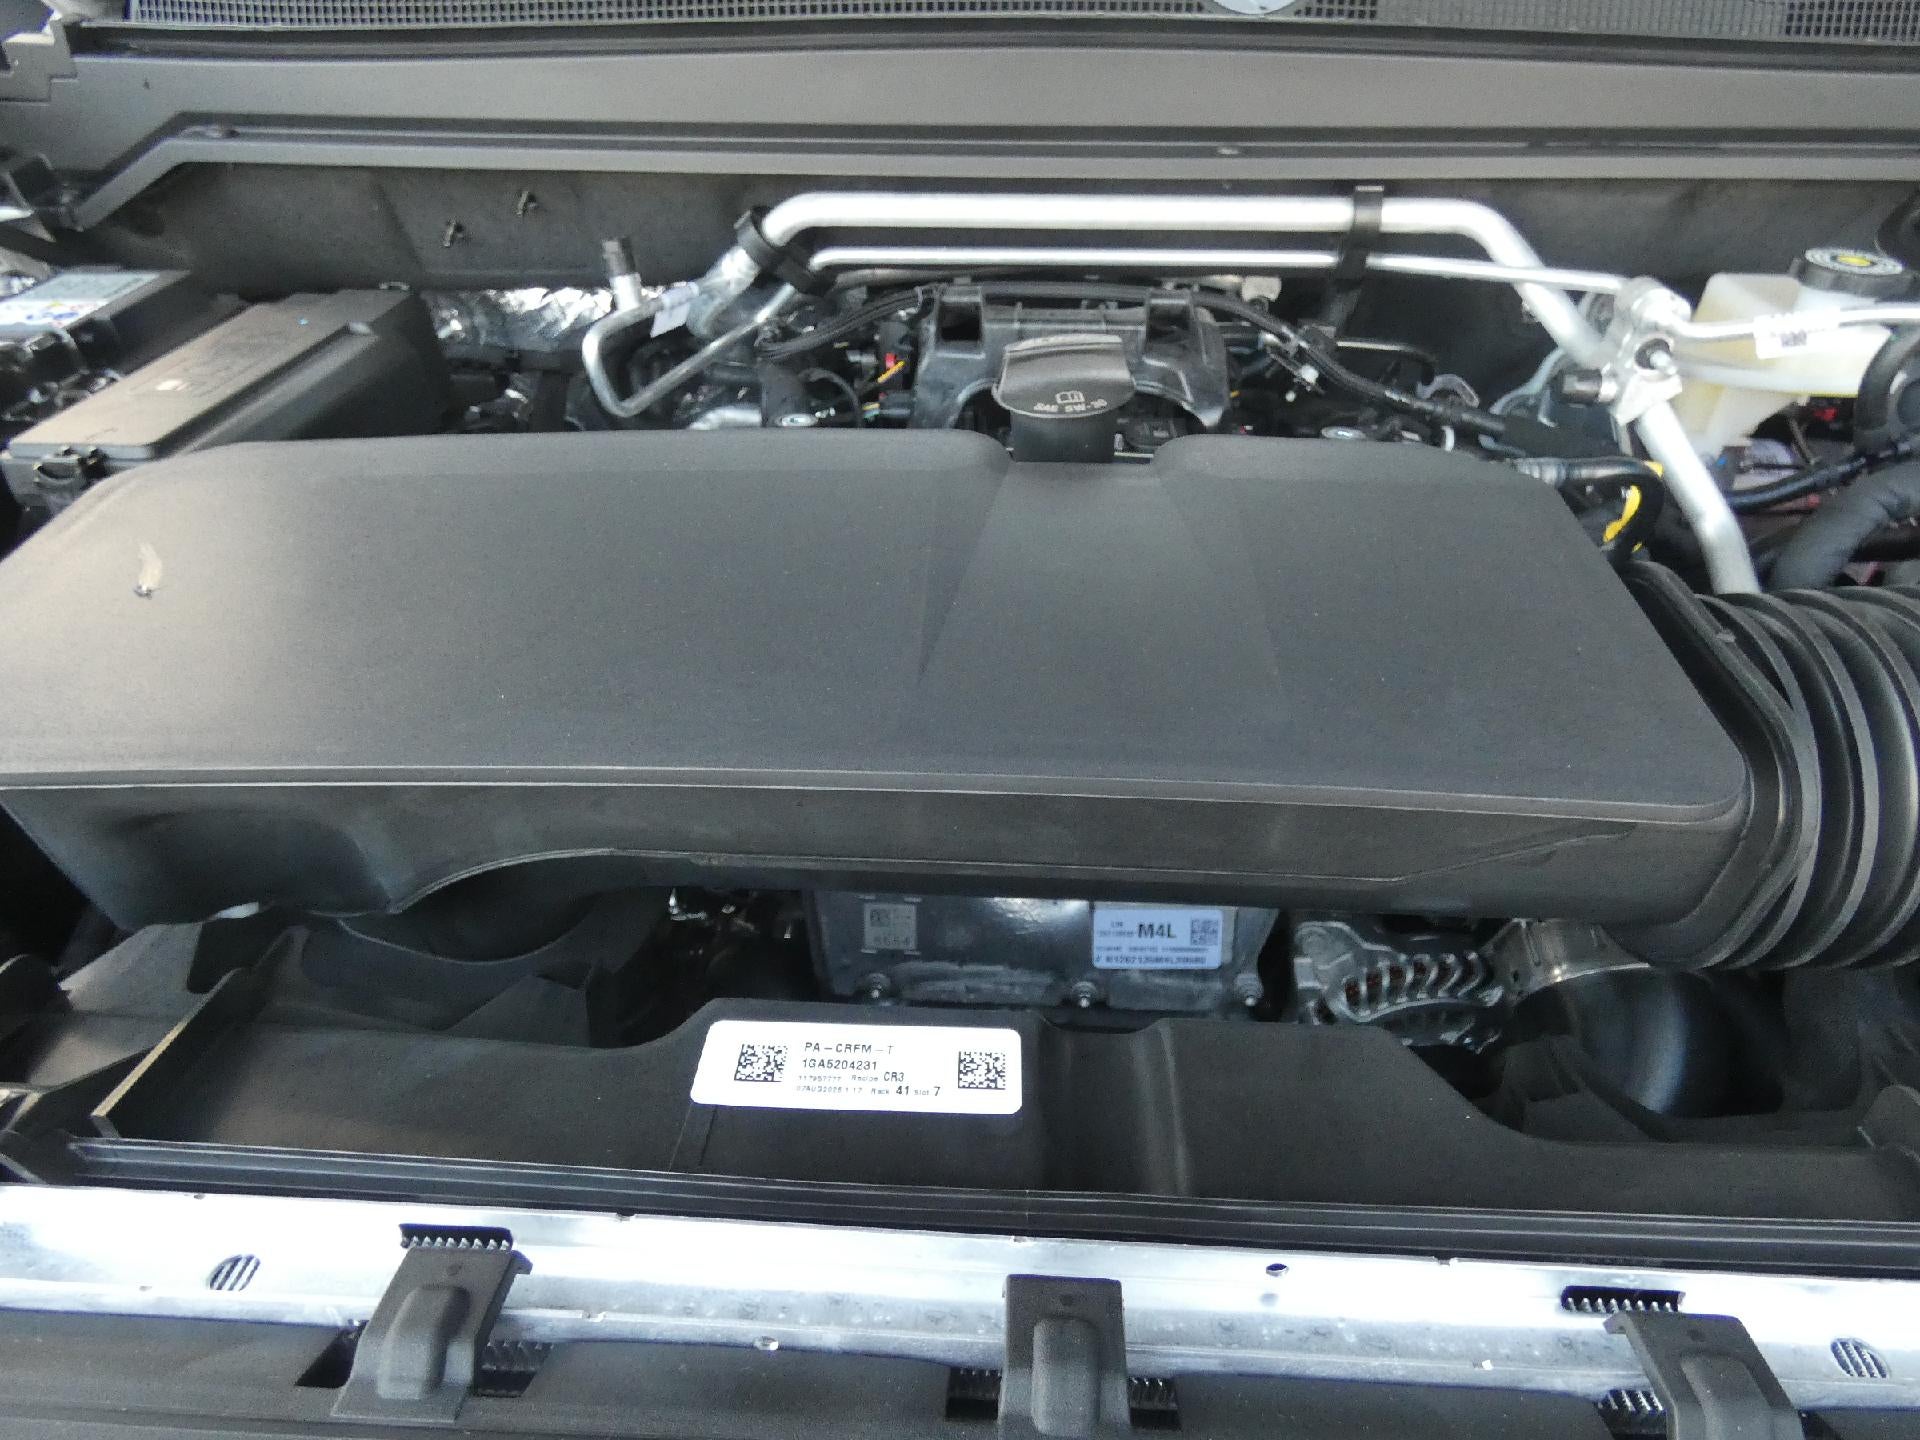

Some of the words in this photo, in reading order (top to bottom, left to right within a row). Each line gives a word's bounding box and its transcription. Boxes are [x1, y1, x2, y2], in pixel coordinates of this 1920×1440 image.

[1137, 921, 1177, 939] M4L
[801, 1057, 877, 1071] 1GA5204231
[883, 1071, 905, 1083] CR3
[895, 1085, 910, 1097] 41
[932, 1085, 942, 1097] 7
